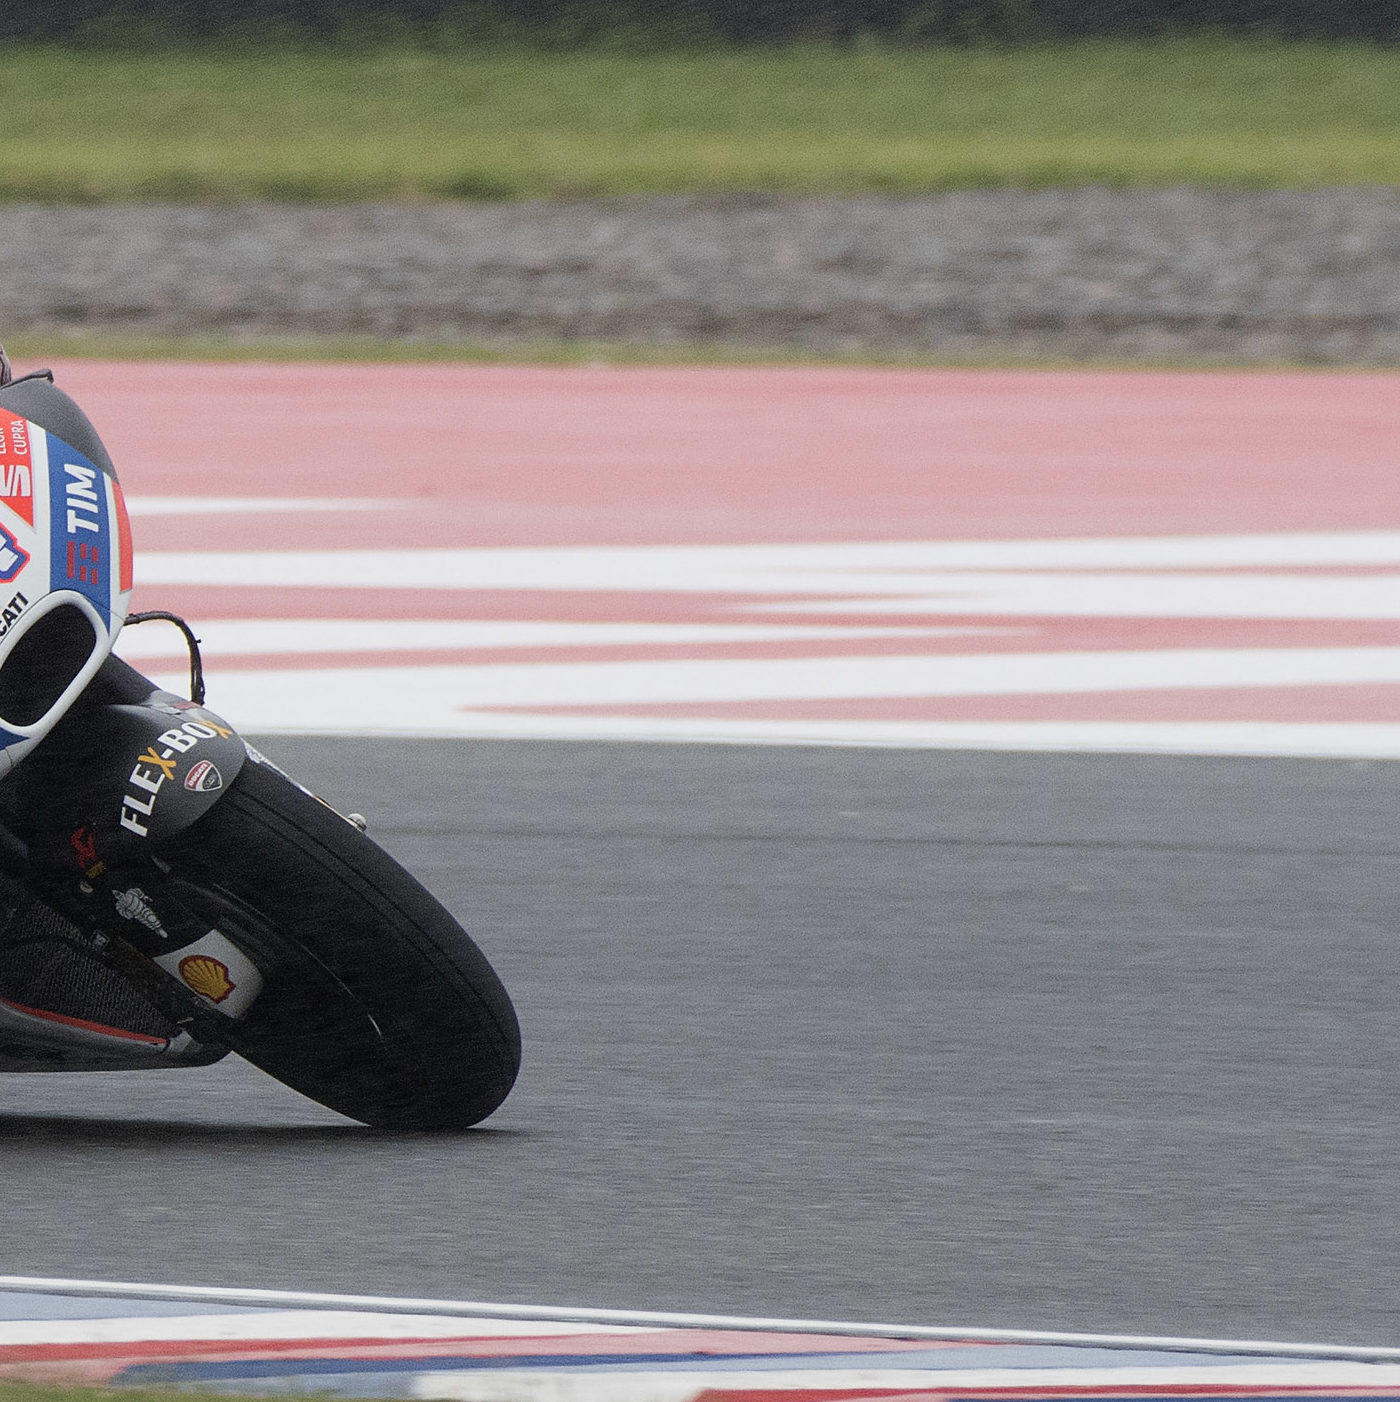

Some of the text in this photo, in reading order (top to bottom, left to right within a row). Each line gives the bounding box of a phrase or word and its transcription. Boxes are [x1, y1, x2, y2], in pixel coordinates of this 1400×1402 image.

[13, 420, 28, 455] CUPRA
[64, 463, 100, 533] TIM
[119, 719, 233, 838] FLEX-BOX
